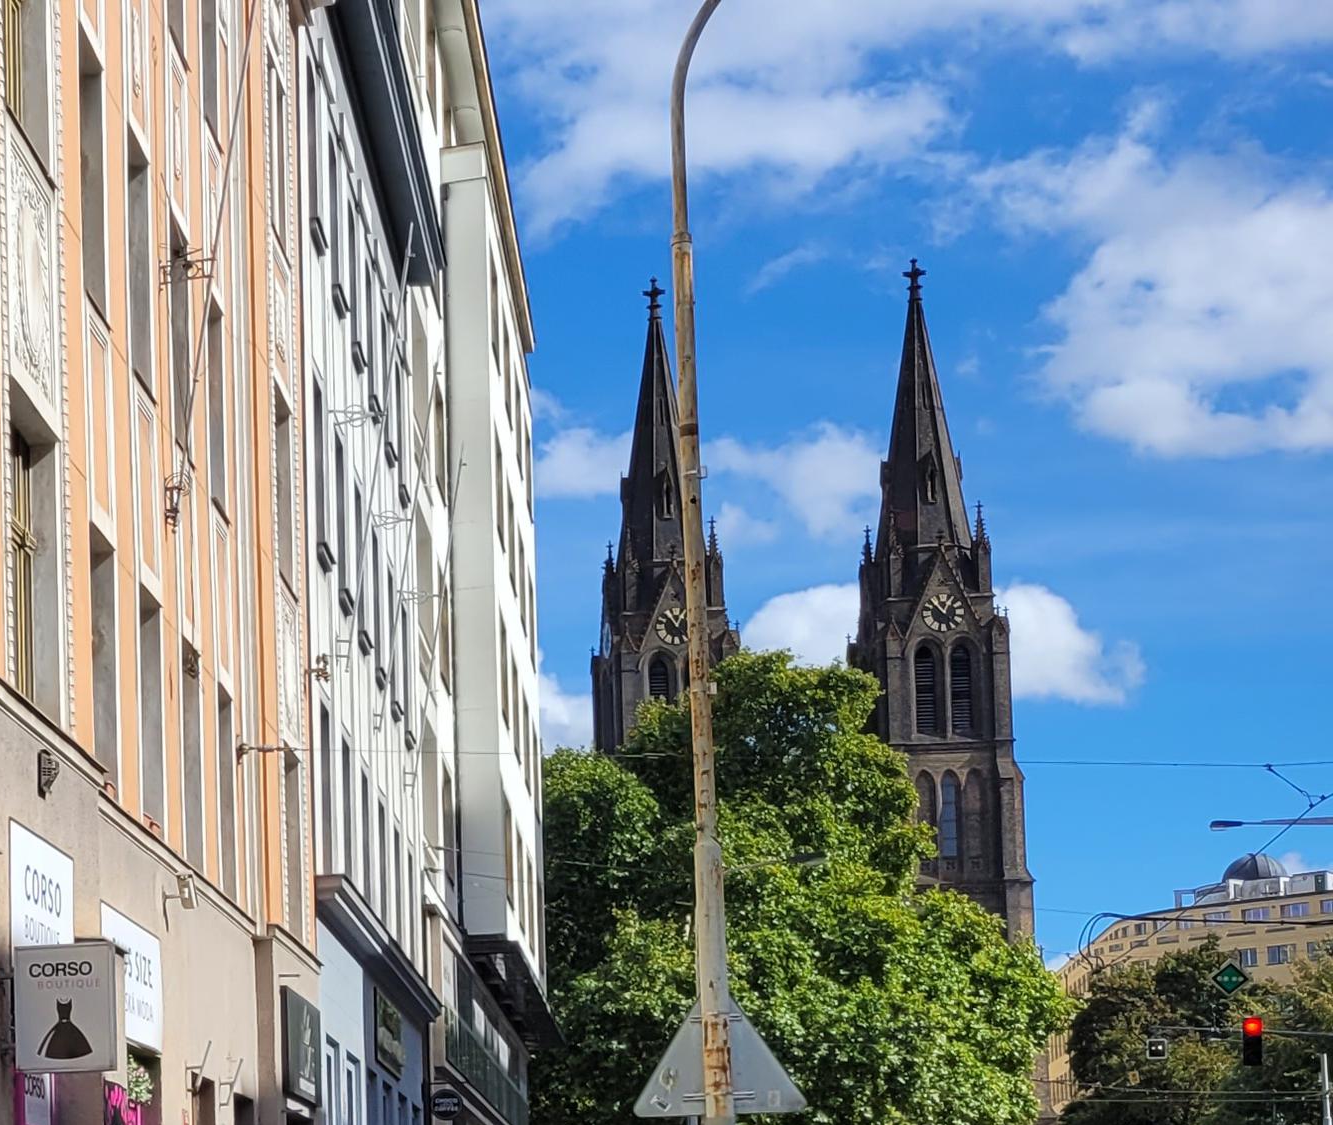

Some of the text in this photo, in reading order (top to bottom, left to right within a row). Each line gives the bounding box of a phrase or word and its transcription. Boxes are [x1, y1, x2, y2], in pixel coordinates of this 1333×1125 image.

[24, 864, 62, 918] CORSO
[28, 961, 93, 978] CORSO
[135, 951, 154, 989] SIZE
[37, 978, 101, 991] BOUTIQUE
